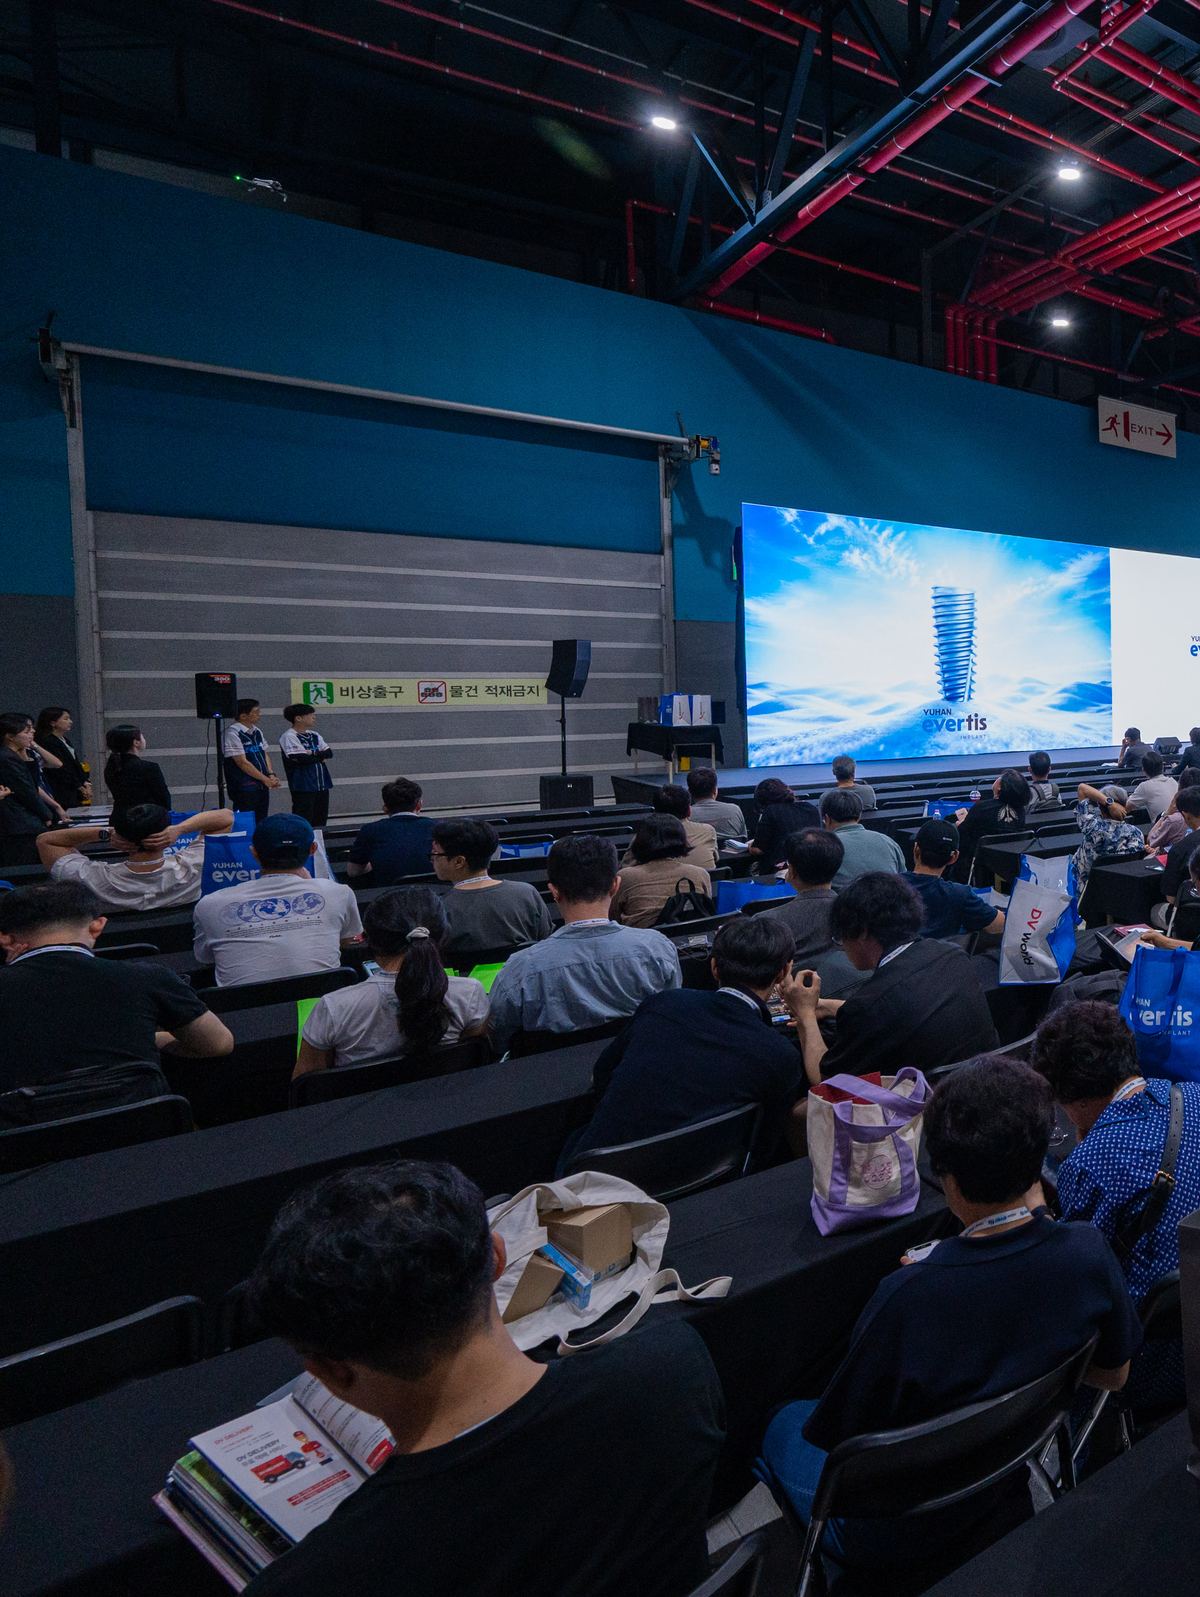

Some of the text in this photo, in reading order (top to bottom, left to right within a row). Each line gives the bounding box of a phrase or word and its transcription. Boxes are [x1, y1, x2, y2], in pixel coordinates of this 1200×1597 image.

[1130, 423, 1155, 437] EXIT
[339, 684, 404, 699] 비상출구
[449, 684, 540, 698] 물건 적재금지
[923, 708, 952, 716] YUHAN
[922, 712, 987, 733] evertis
[212, 869, 260, 883] ever
[1020, 908, 1042, 966] DV world
